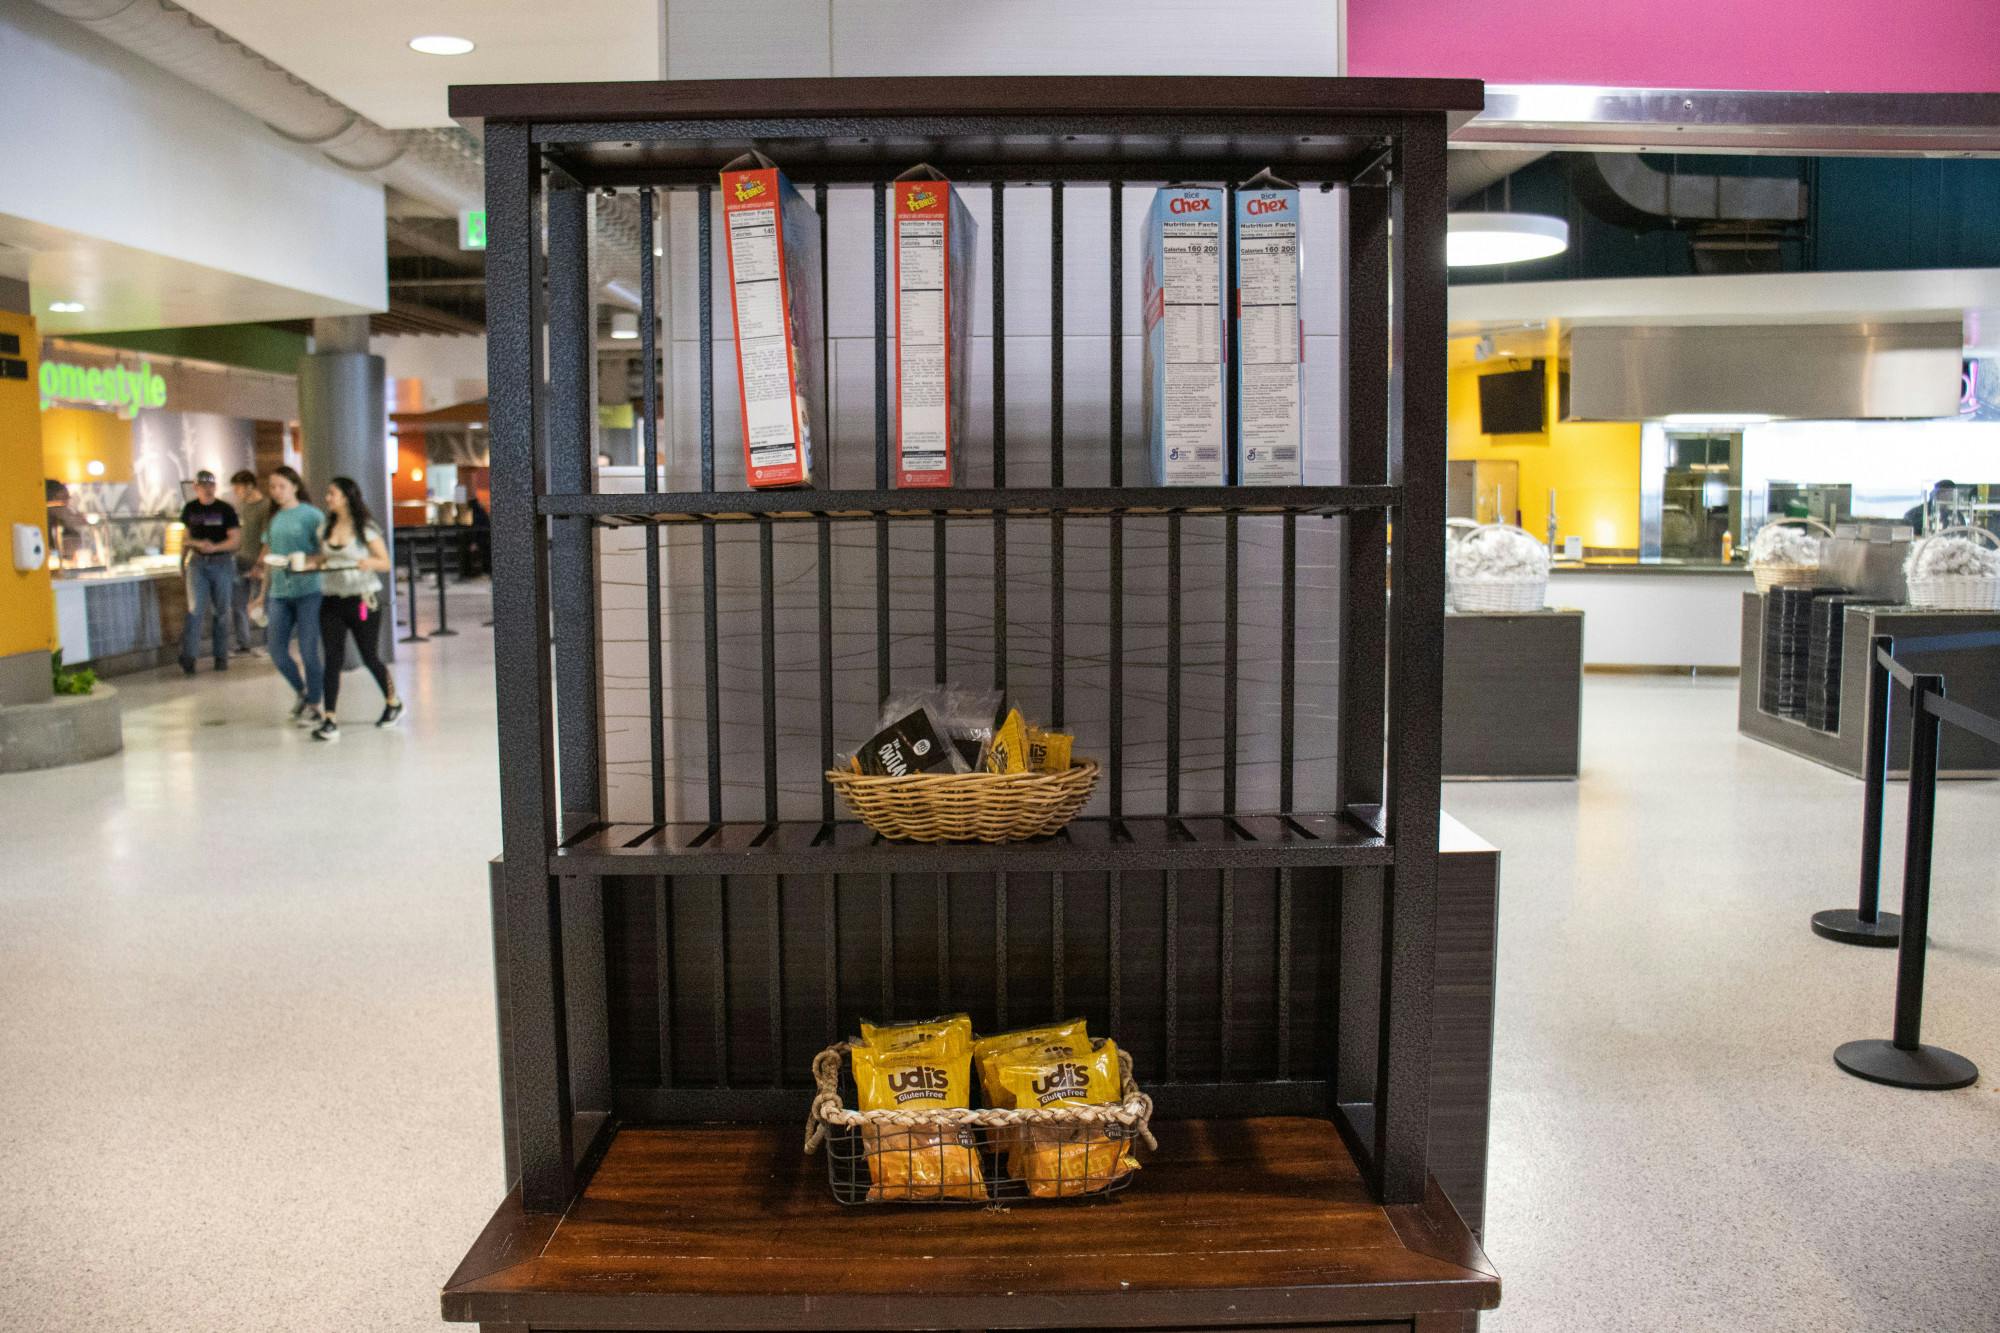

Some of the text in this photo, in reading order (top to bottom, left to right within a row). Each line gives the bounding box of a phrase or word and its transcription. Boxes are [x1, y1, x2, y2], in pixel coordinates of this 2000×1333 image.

[1169, 197, 1211, 215] Chex
[1247, 198, 1289, 216] Chex
[887, 1065, 949, 1093] udi's
[1031, 1063, 1090, 1095] udi's
[897, 1090, 944, 1103] Gluten Free
[1041, 1089, 1085, 1105] Gluten Free
